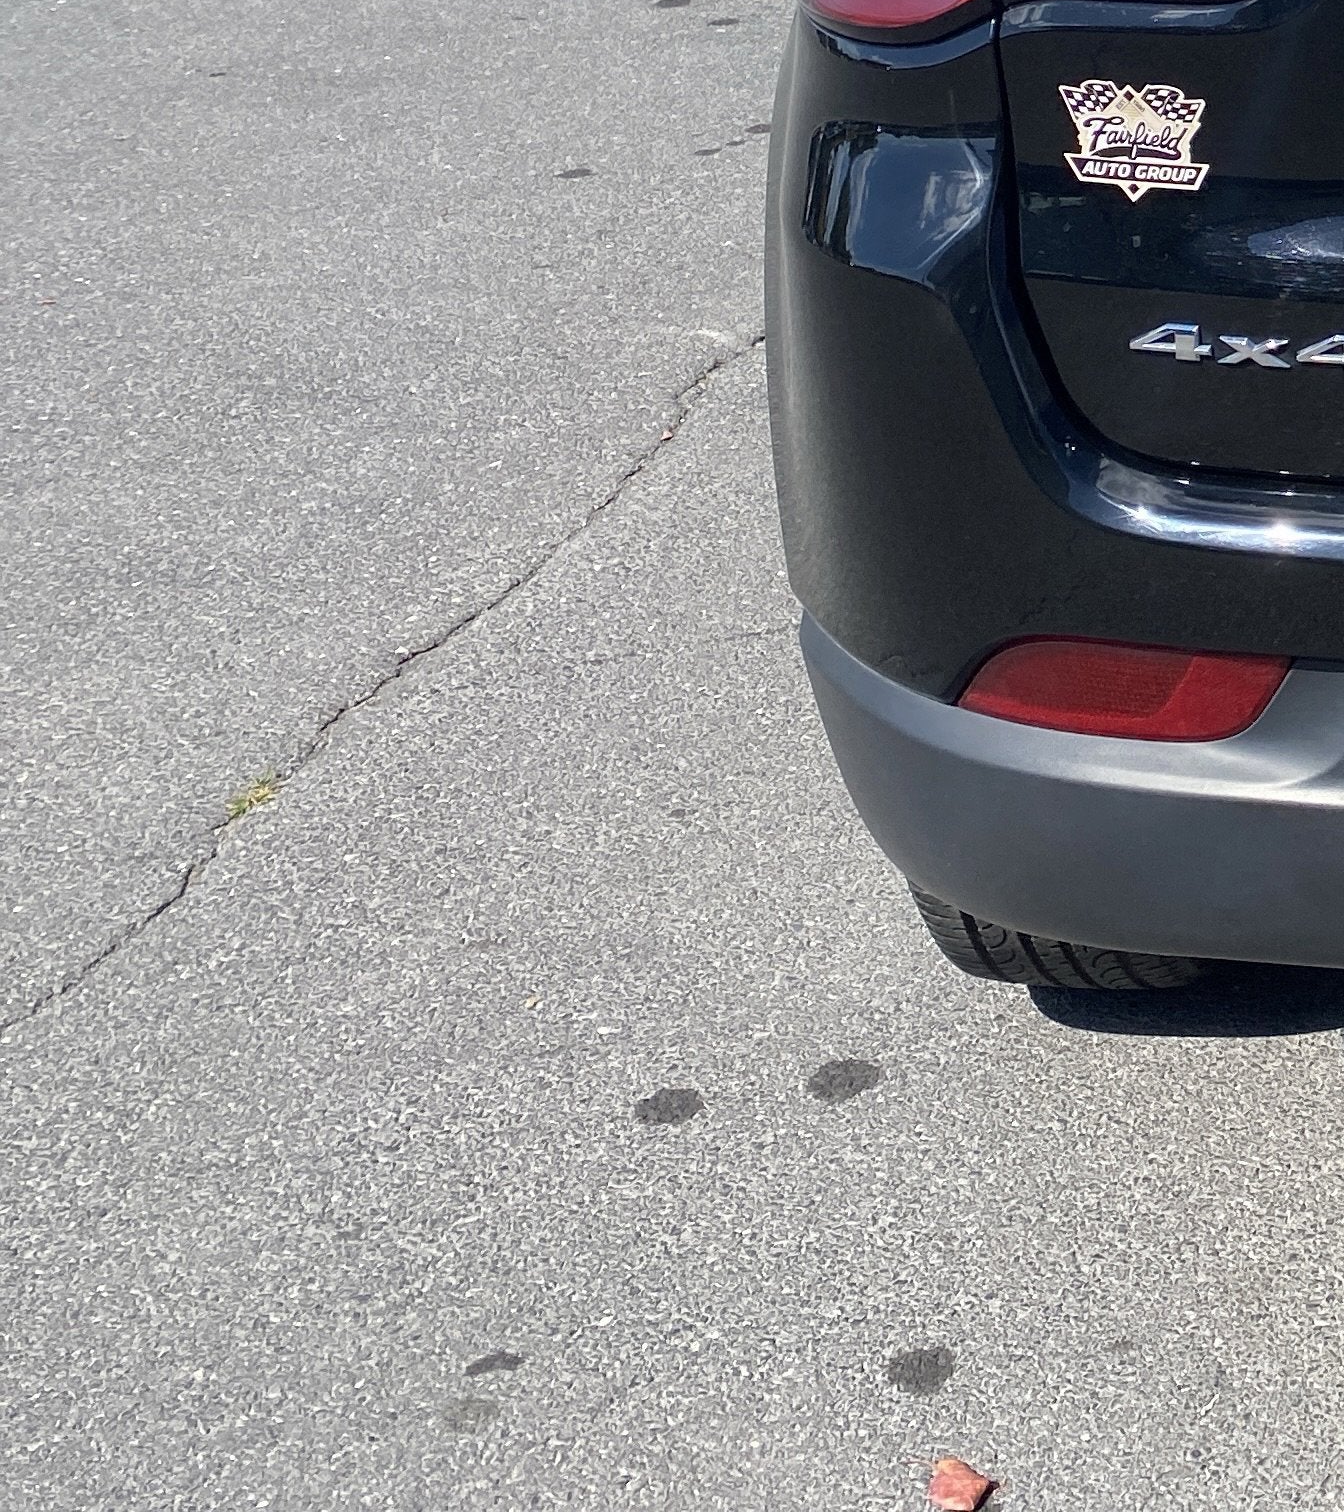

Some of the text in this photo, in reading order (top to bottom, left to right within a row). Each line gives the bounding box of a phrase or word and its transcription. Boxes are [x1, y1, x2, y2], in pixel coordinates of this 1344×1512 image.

[1082, 115, 1188, 160] Fairfield
[1081, 159, 1198, 182] AUTO GROUP
